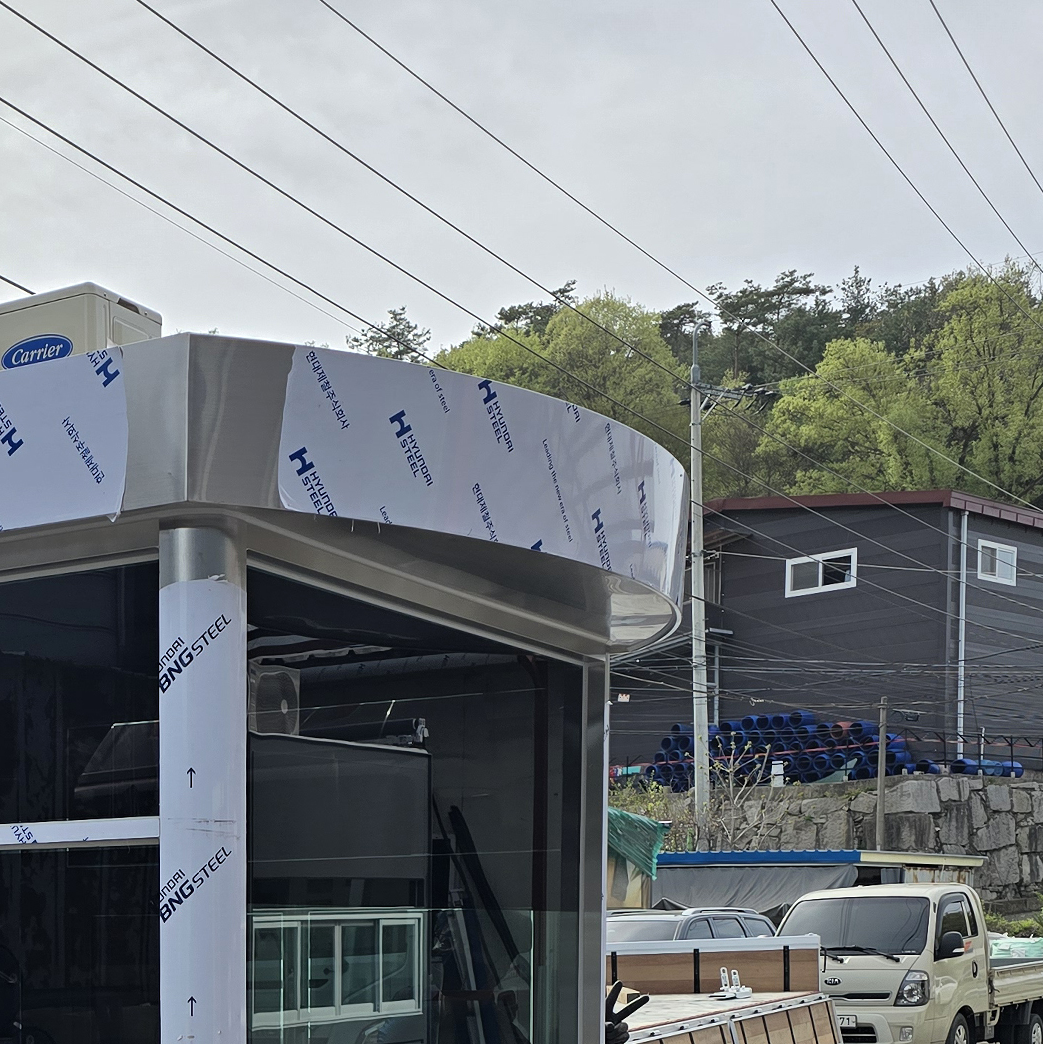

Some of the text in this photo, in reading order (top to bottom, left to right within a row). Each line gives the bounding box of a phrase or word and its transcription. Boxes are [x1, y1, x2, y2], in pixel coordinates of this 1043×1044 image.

[11, 343, 64, 365] Carrier
[306, 350, 351, 430] 현대제철주식회사
[437, 394, 451, 414] steel
[486, 405, 502, 444] STEEL
[492, 401, 515, 454] HYUNDAI
[400, 438, 419, 478] STEEL
[407, 434, 434, 487] HYUNDAI
[309, 471, 339, 517] HYUND
